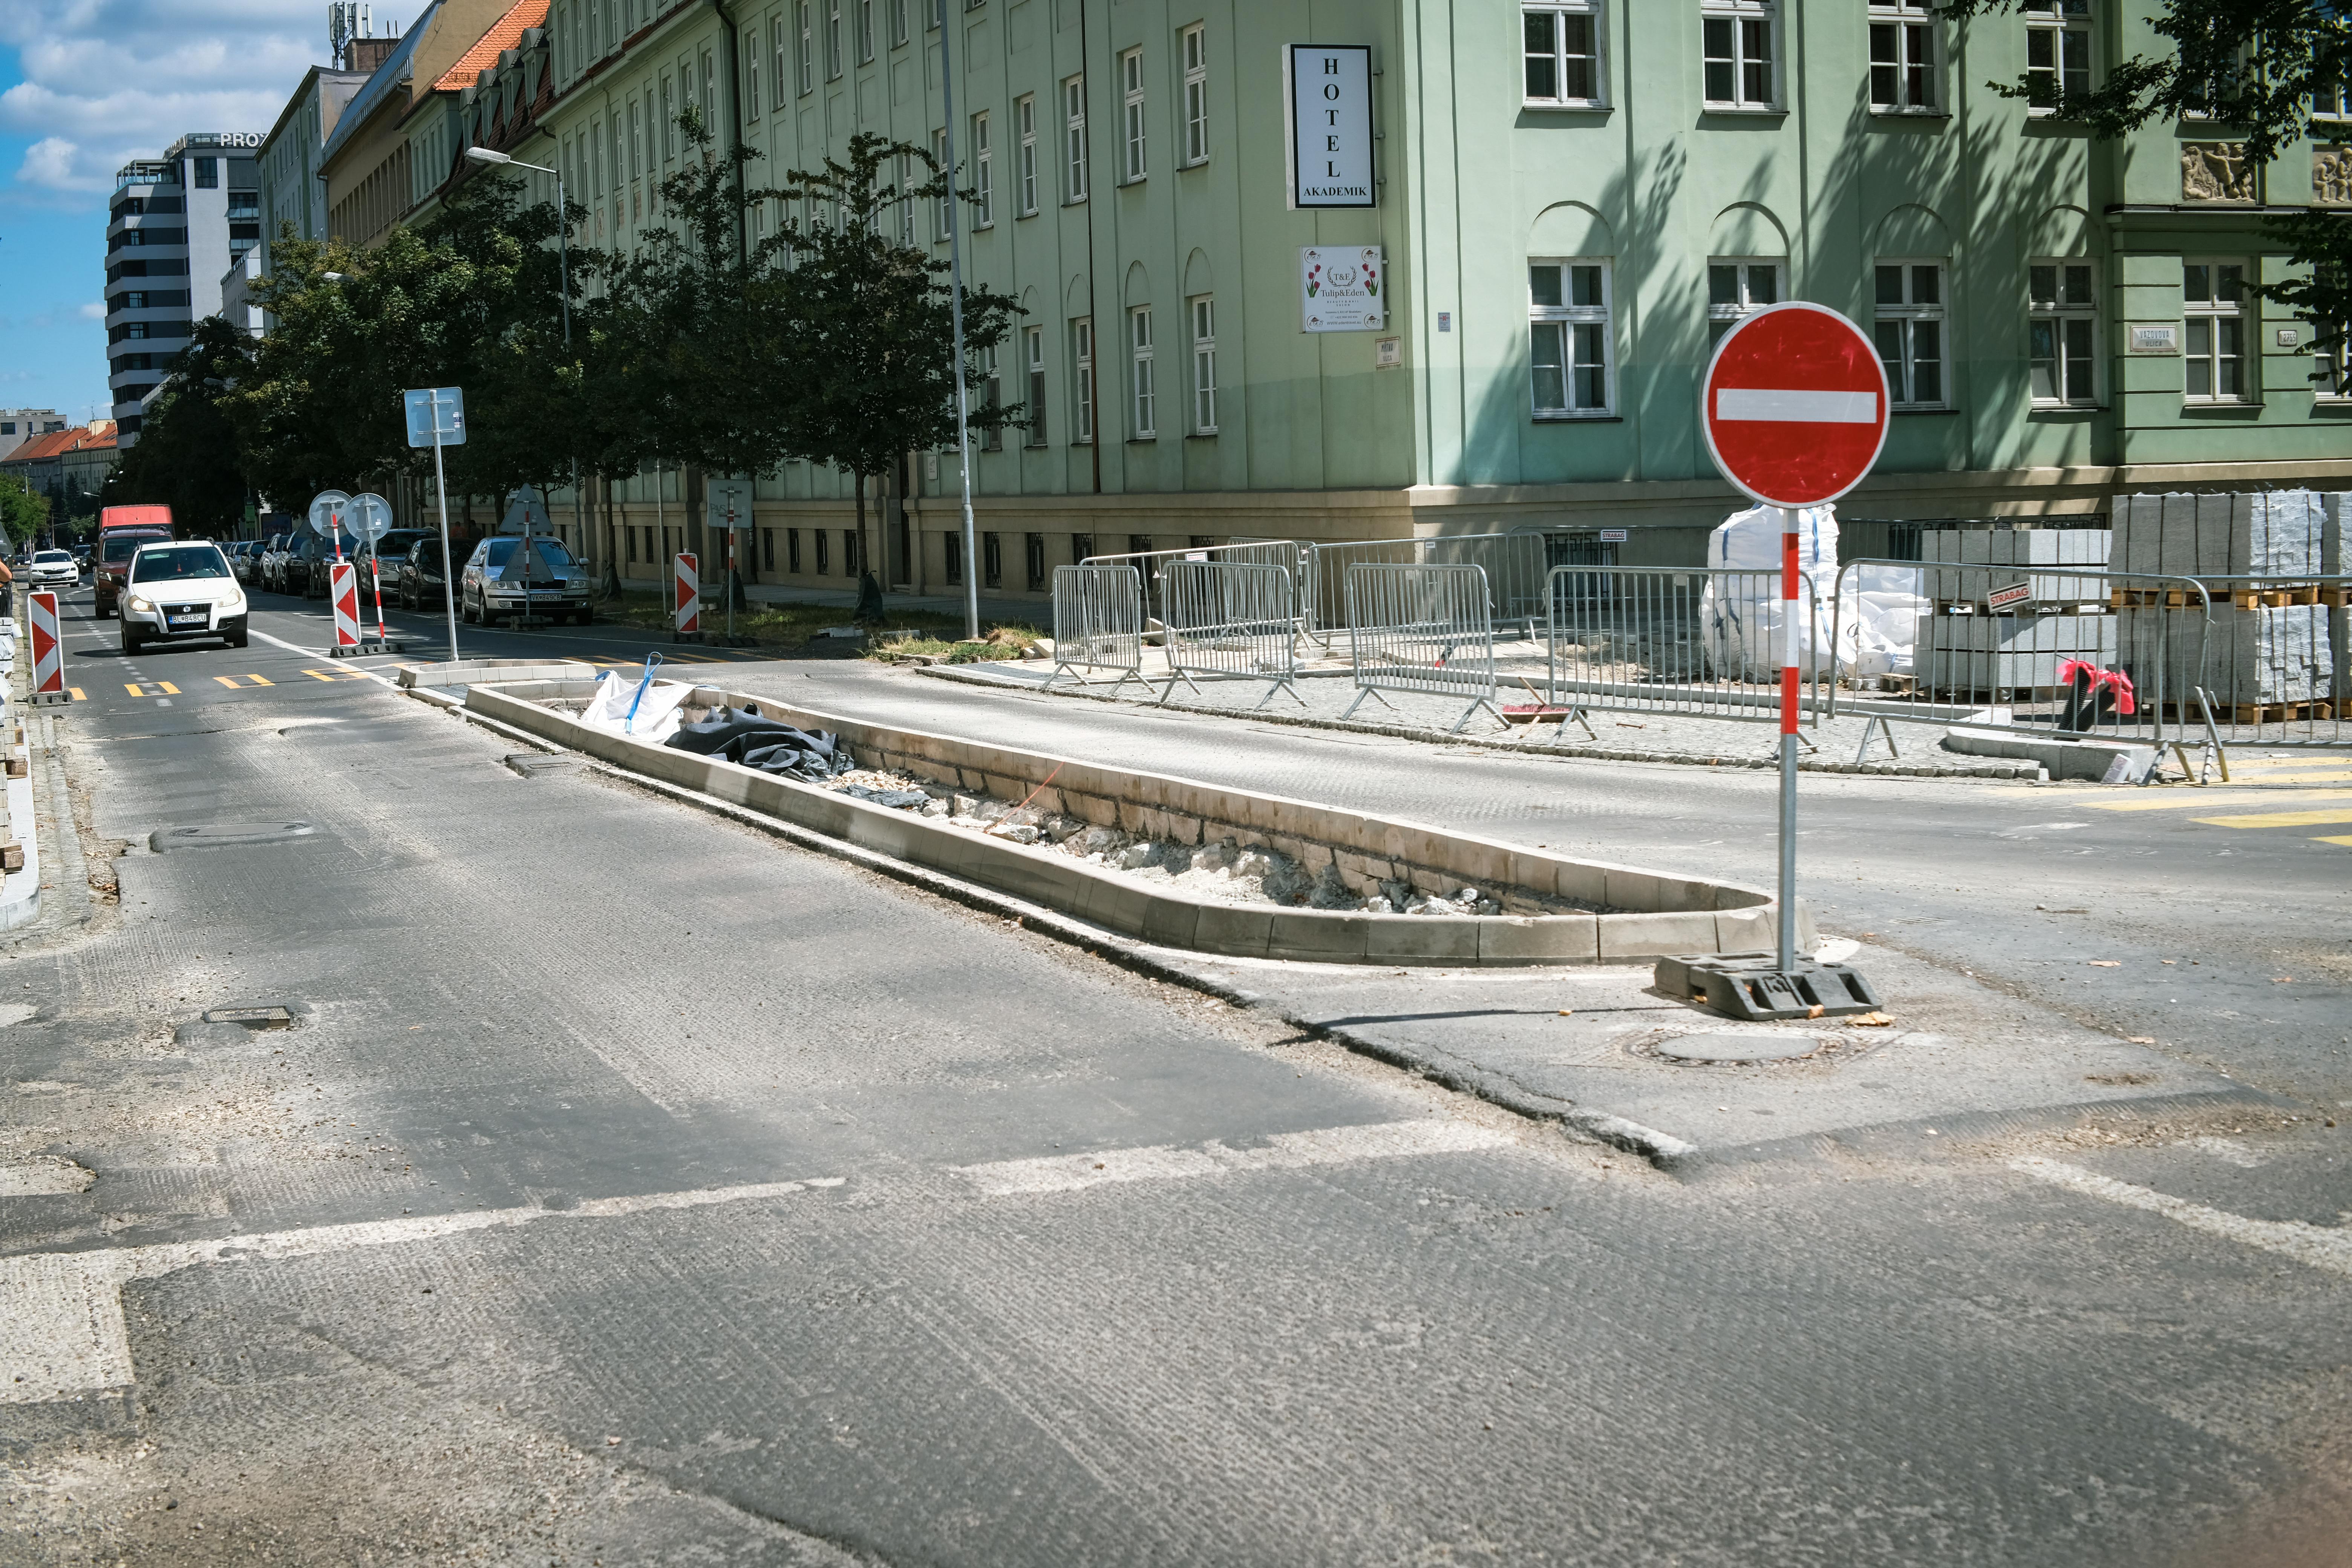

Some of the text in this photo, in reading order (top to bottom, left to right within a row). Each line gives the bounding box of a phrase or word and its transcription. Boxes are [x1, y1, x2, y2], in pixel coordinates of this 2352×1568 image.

[1323, 58, 1340, 177] HOTEL
[1303, 187, 1367, 196] AKADEMIK
[1320, 289, 1365, 298] Tulip&Eden
[2140, 330, 2169, 338] VAZOVOVA
[1991, 588, 2029, 605] STRABAG
